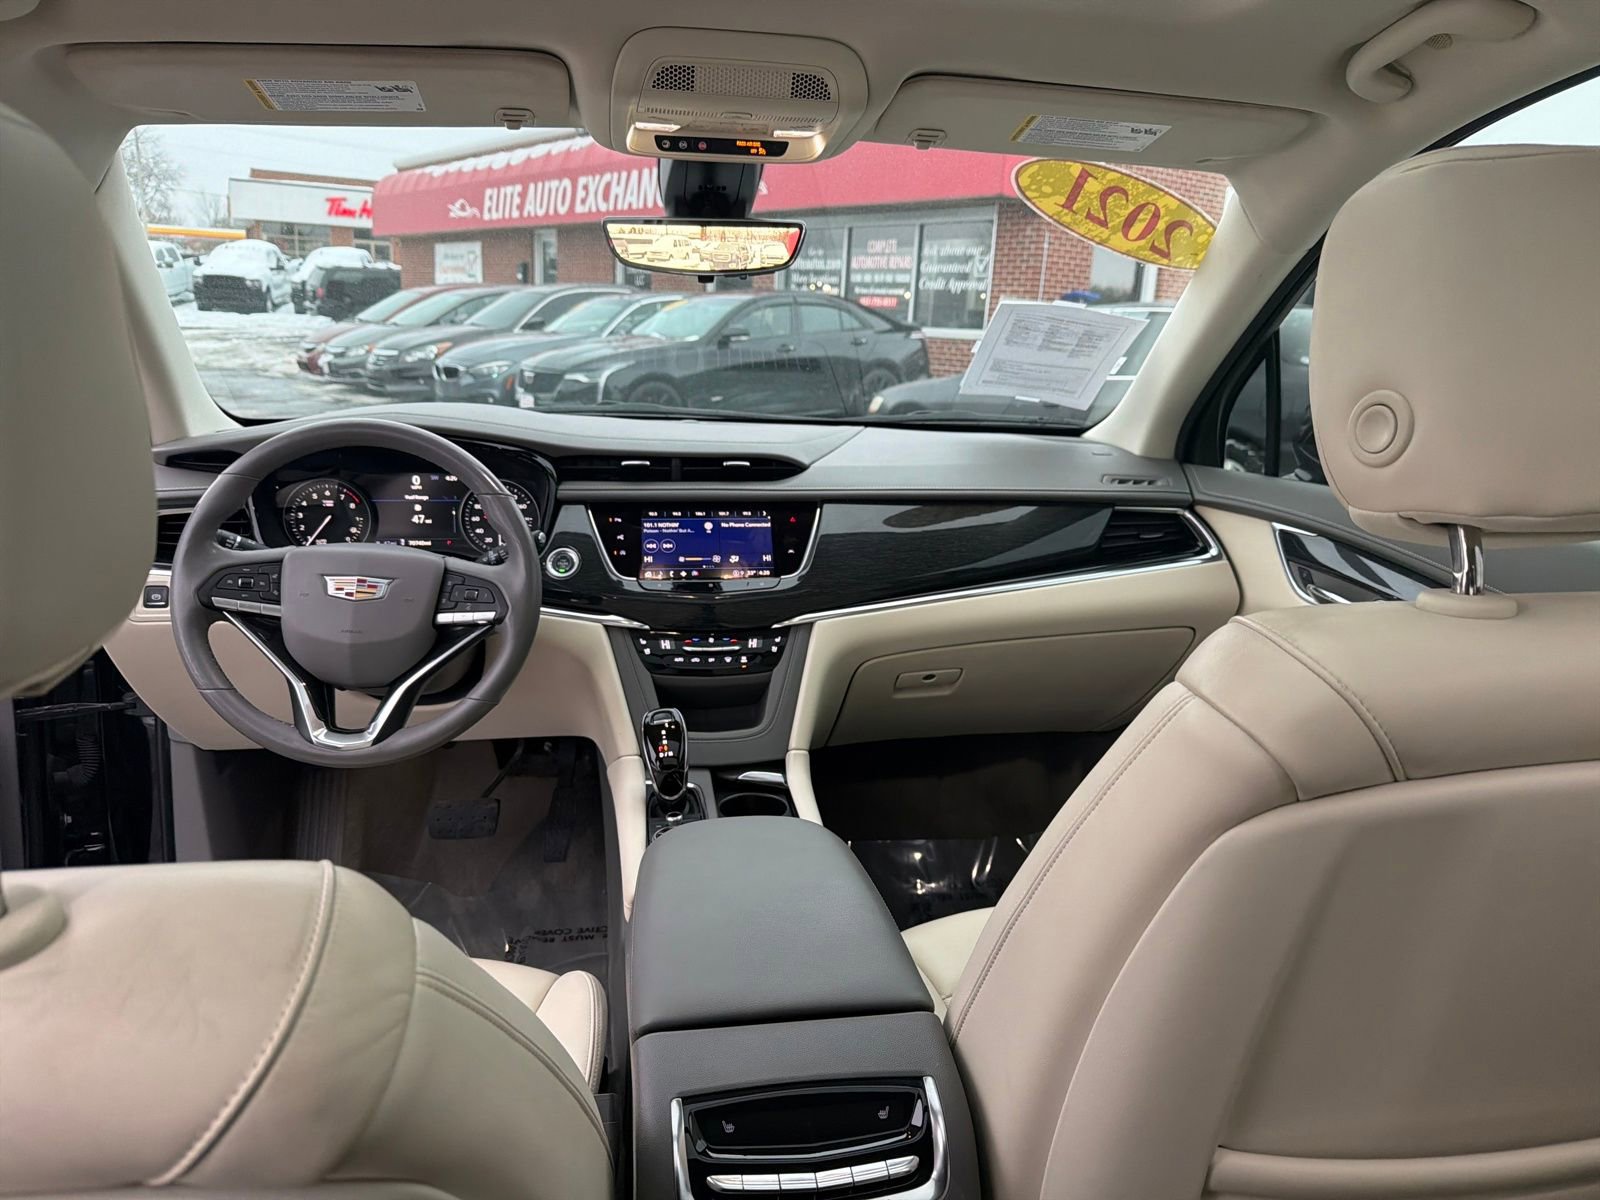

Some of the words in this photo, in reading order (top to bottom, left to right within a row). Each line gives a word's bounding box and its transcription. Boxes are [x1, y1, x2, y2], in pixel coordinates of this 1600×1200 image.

[482, 181, 523, 221] ELITE
[523, 176, 571, 218] AUTO
[325, 196, 357, 218] Tim
[940, 245, 964, 257] about
[918, 277, 946, 291] Credit
[946, 277, 989, 295] Approval
[324, 489, 331, 497] 6
[410, 514, 425, 524] 47
[762, 554, 772, 562] HI
[660, 639, 671, 650] HI
[748, 638, 758, 648] HI
